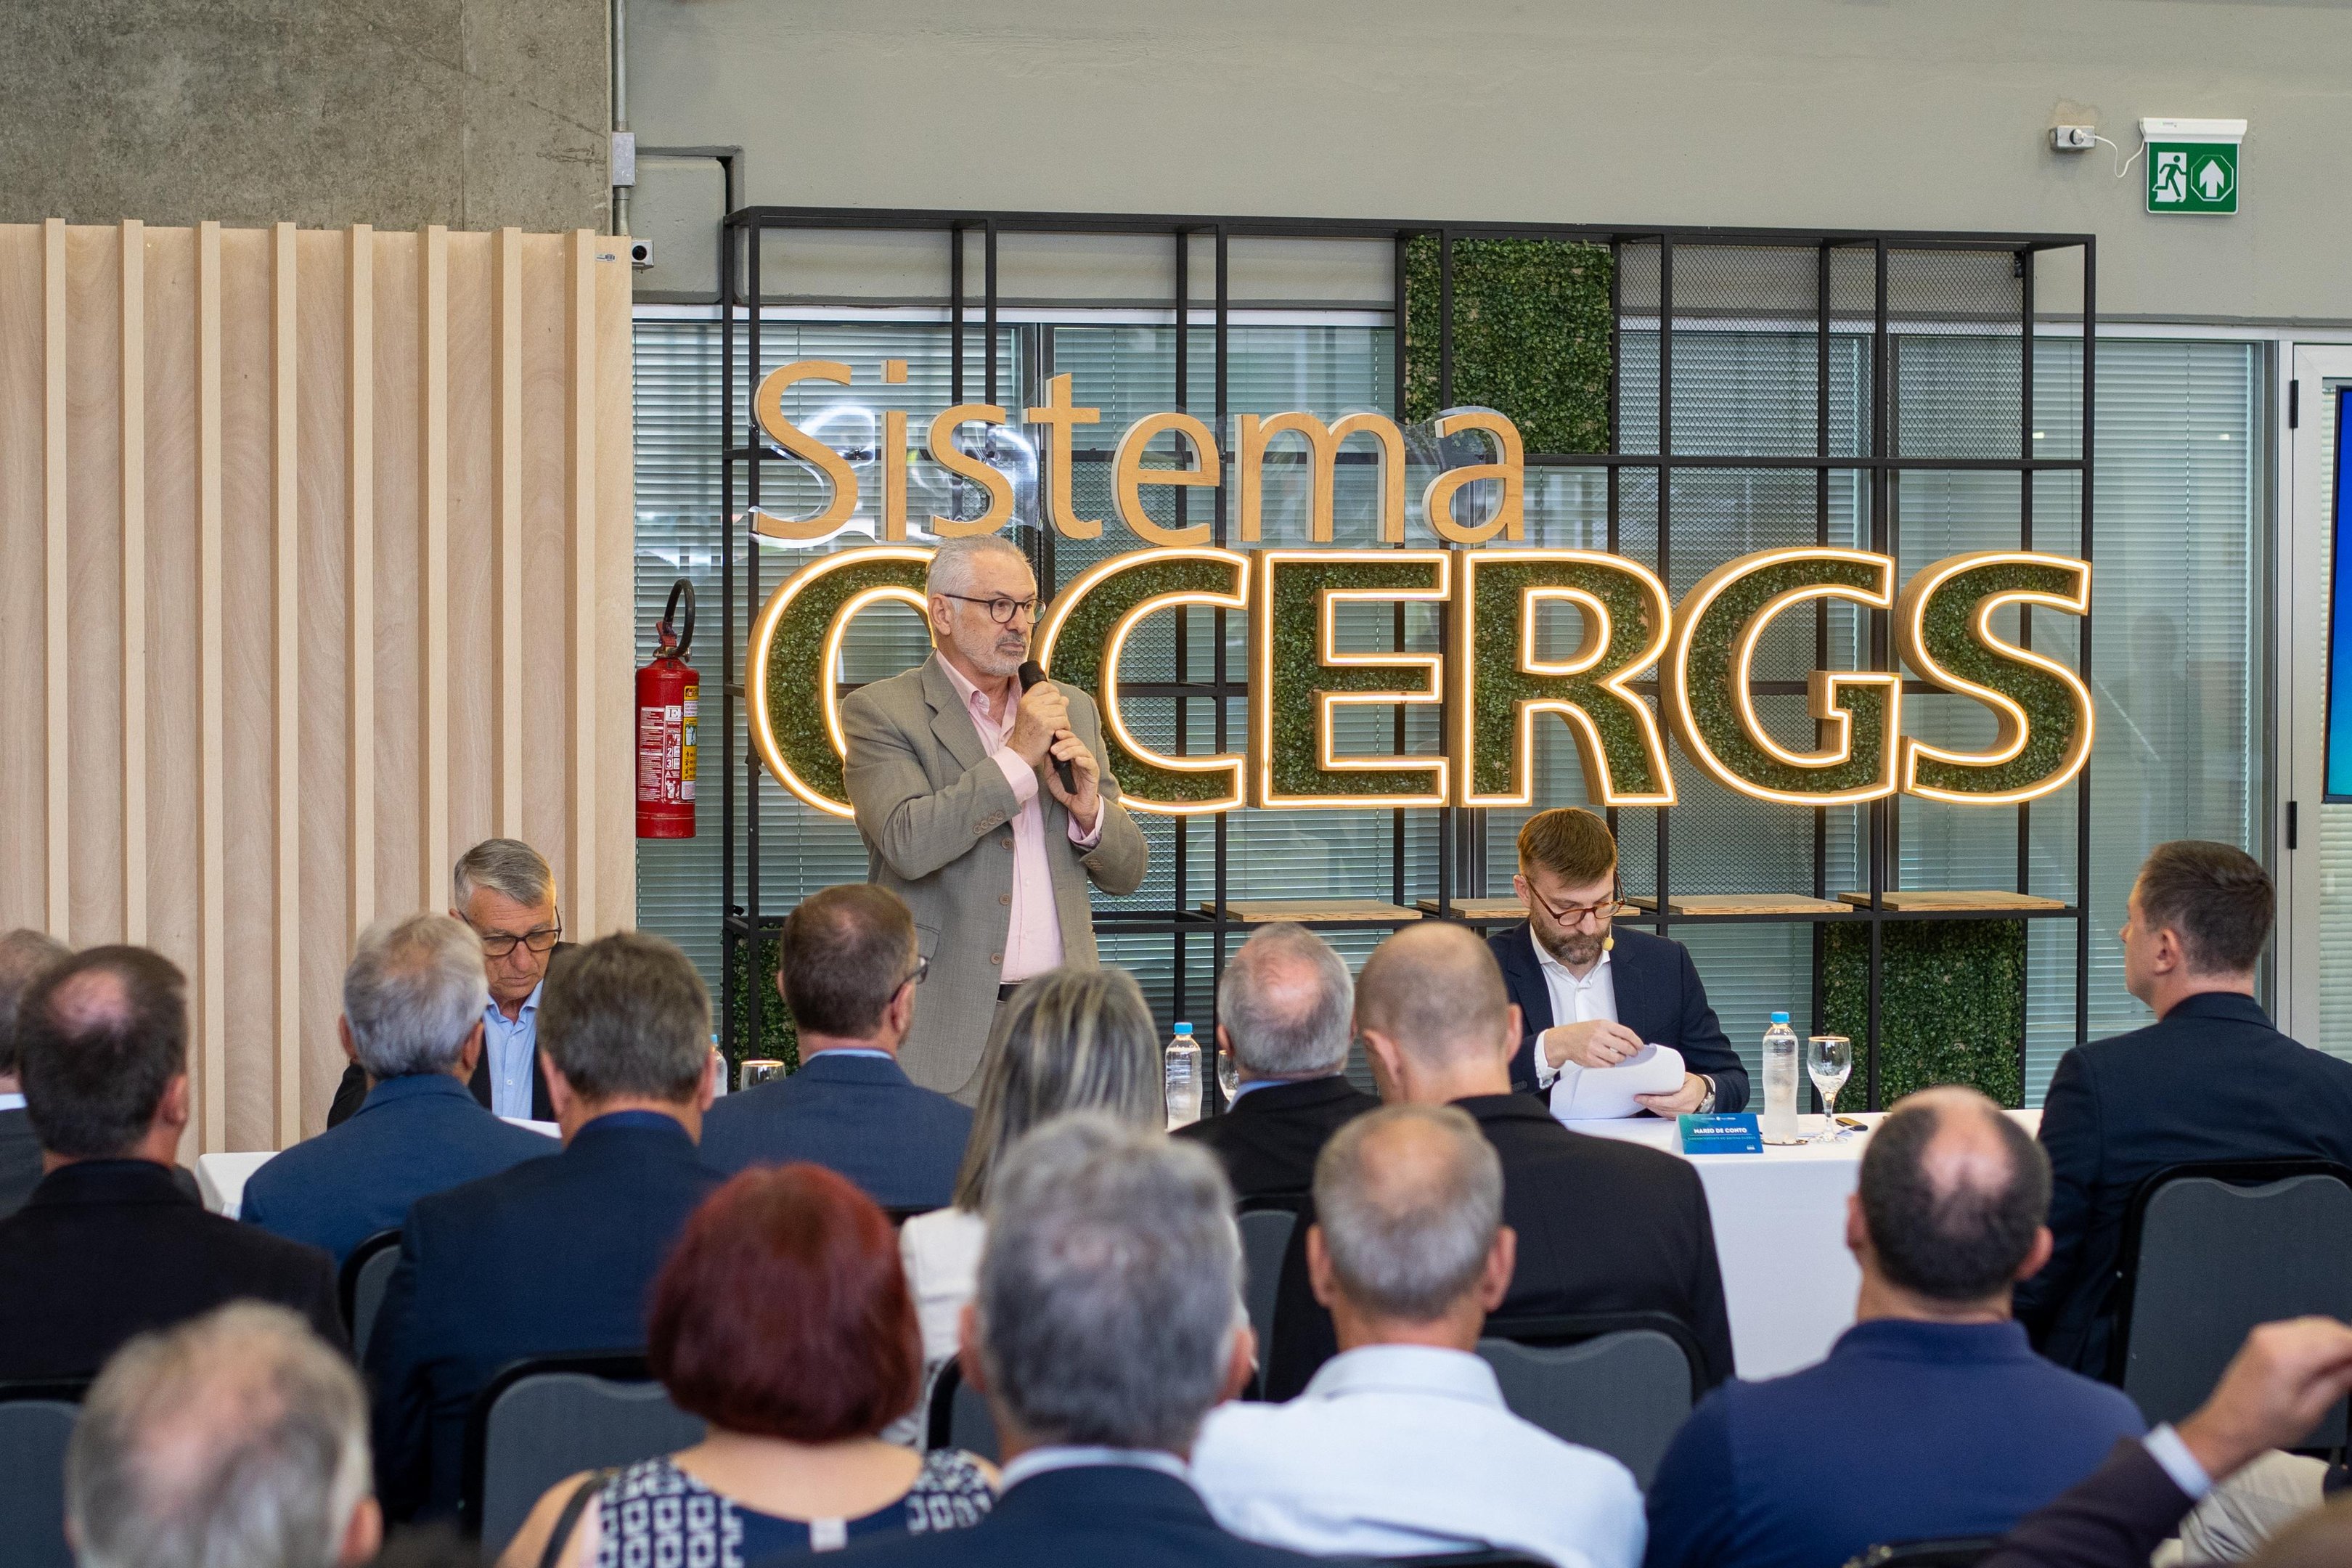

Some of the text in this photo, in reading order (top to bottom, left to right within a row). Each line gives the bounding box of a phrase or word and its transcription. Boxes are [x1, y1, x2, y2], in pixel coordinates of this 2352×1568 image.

[751, 359, 1524, 546] Sistema
[667, 748, 672, 756] 2
[666, 759, 671, 769] 3
